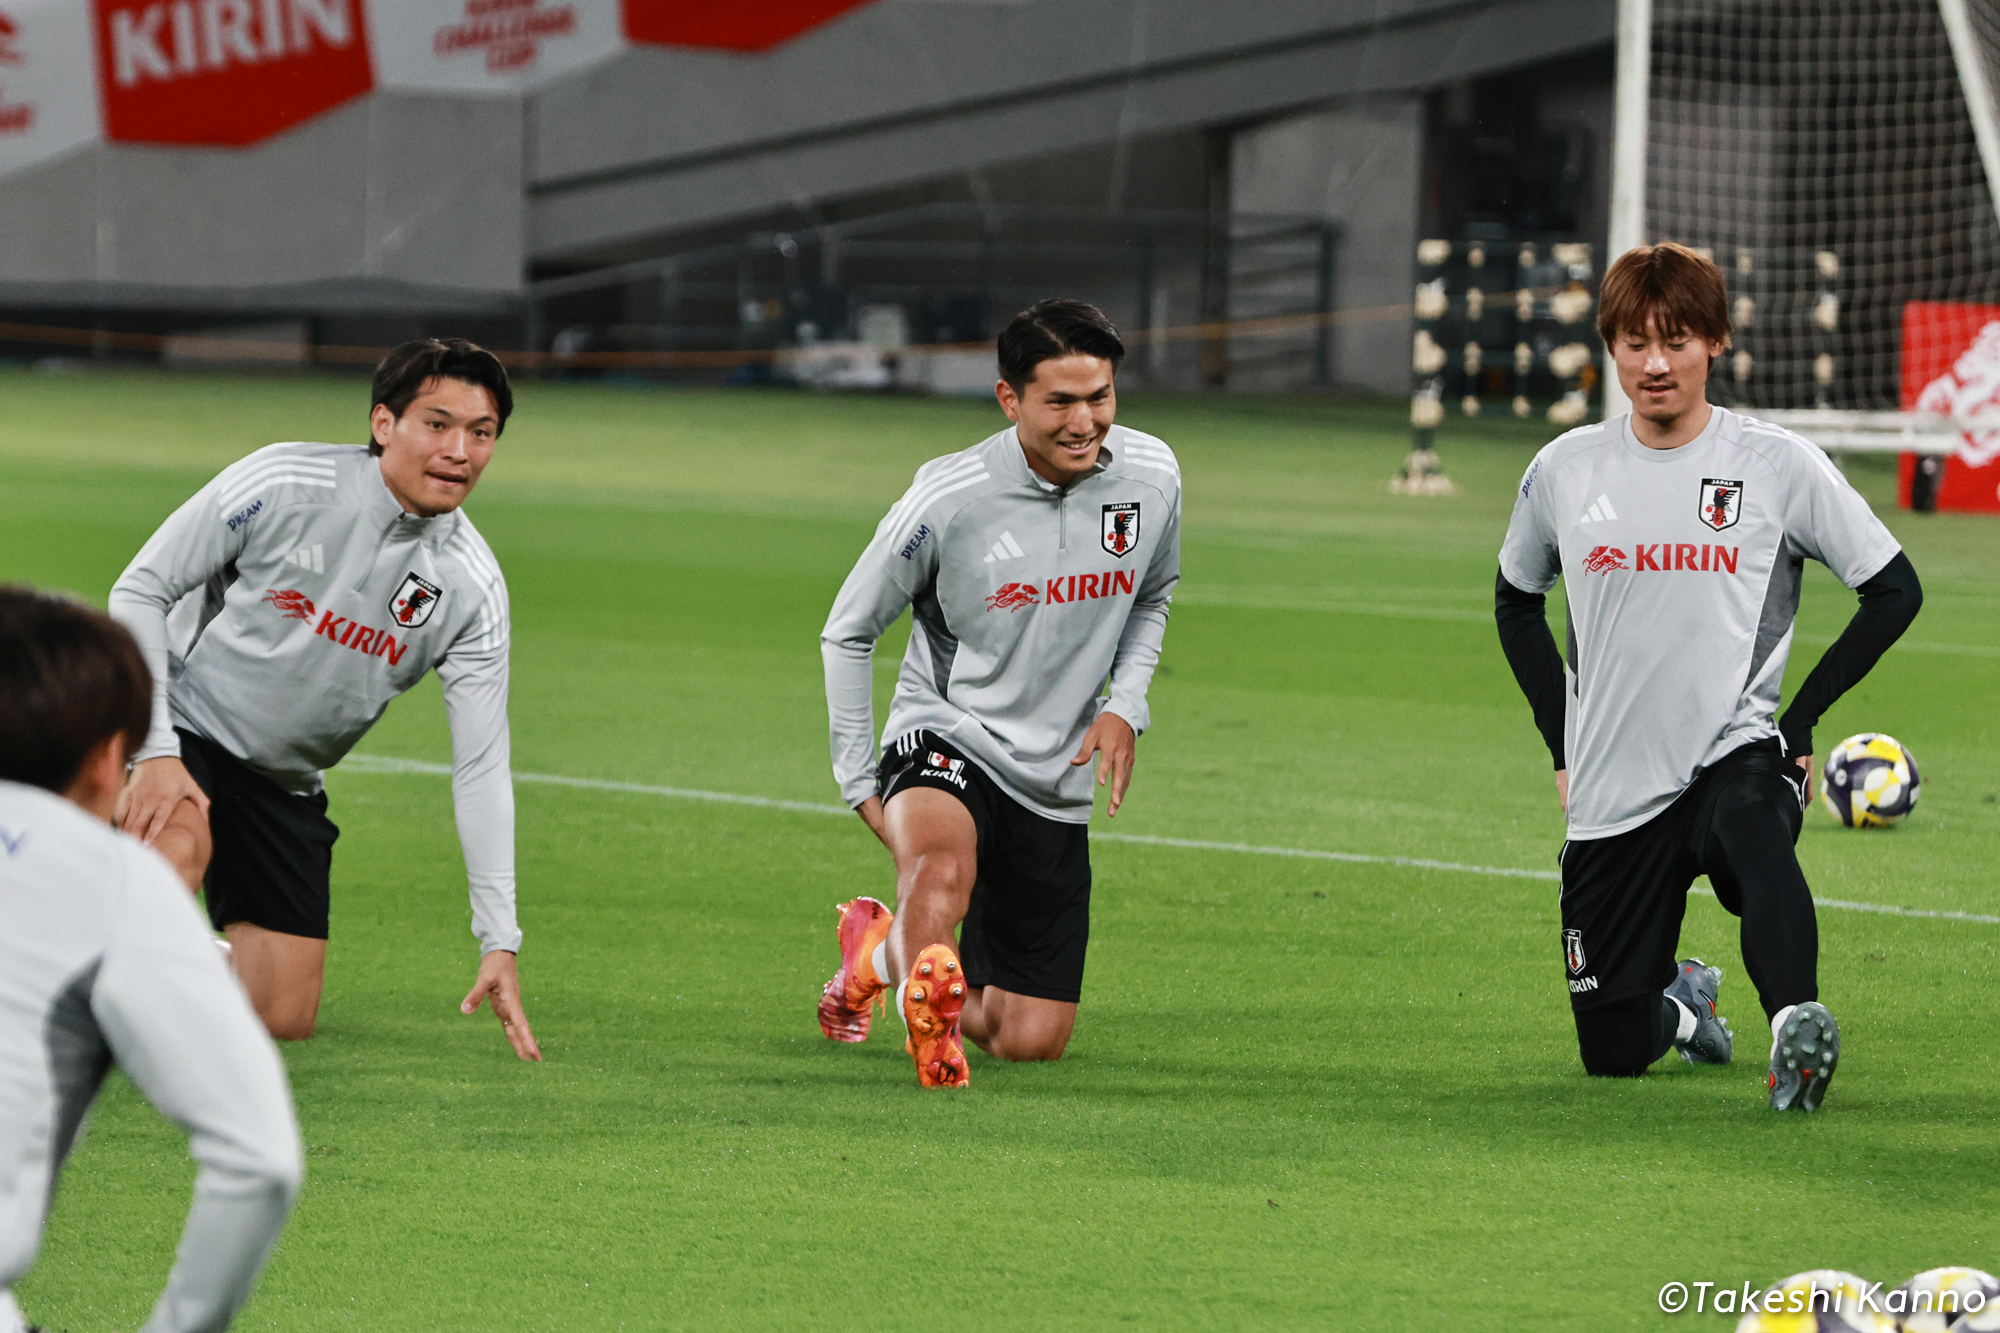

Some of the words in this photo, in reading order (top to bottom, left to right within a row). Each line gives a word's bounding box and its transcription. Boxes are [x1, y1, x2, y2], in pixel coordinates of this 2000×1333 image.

[111, 0, 350, 87] KIRIN
[226, 500, 262, 531] DREAM
[901, 524, 931, 560] DREAM
[1635, 543, 1739, 575] KIRIN
[1045, 569, 1135, 605] KIRIN
[315, 609, 407, 666] KIRIN
[920, 769, 967, 790] KIRIN
